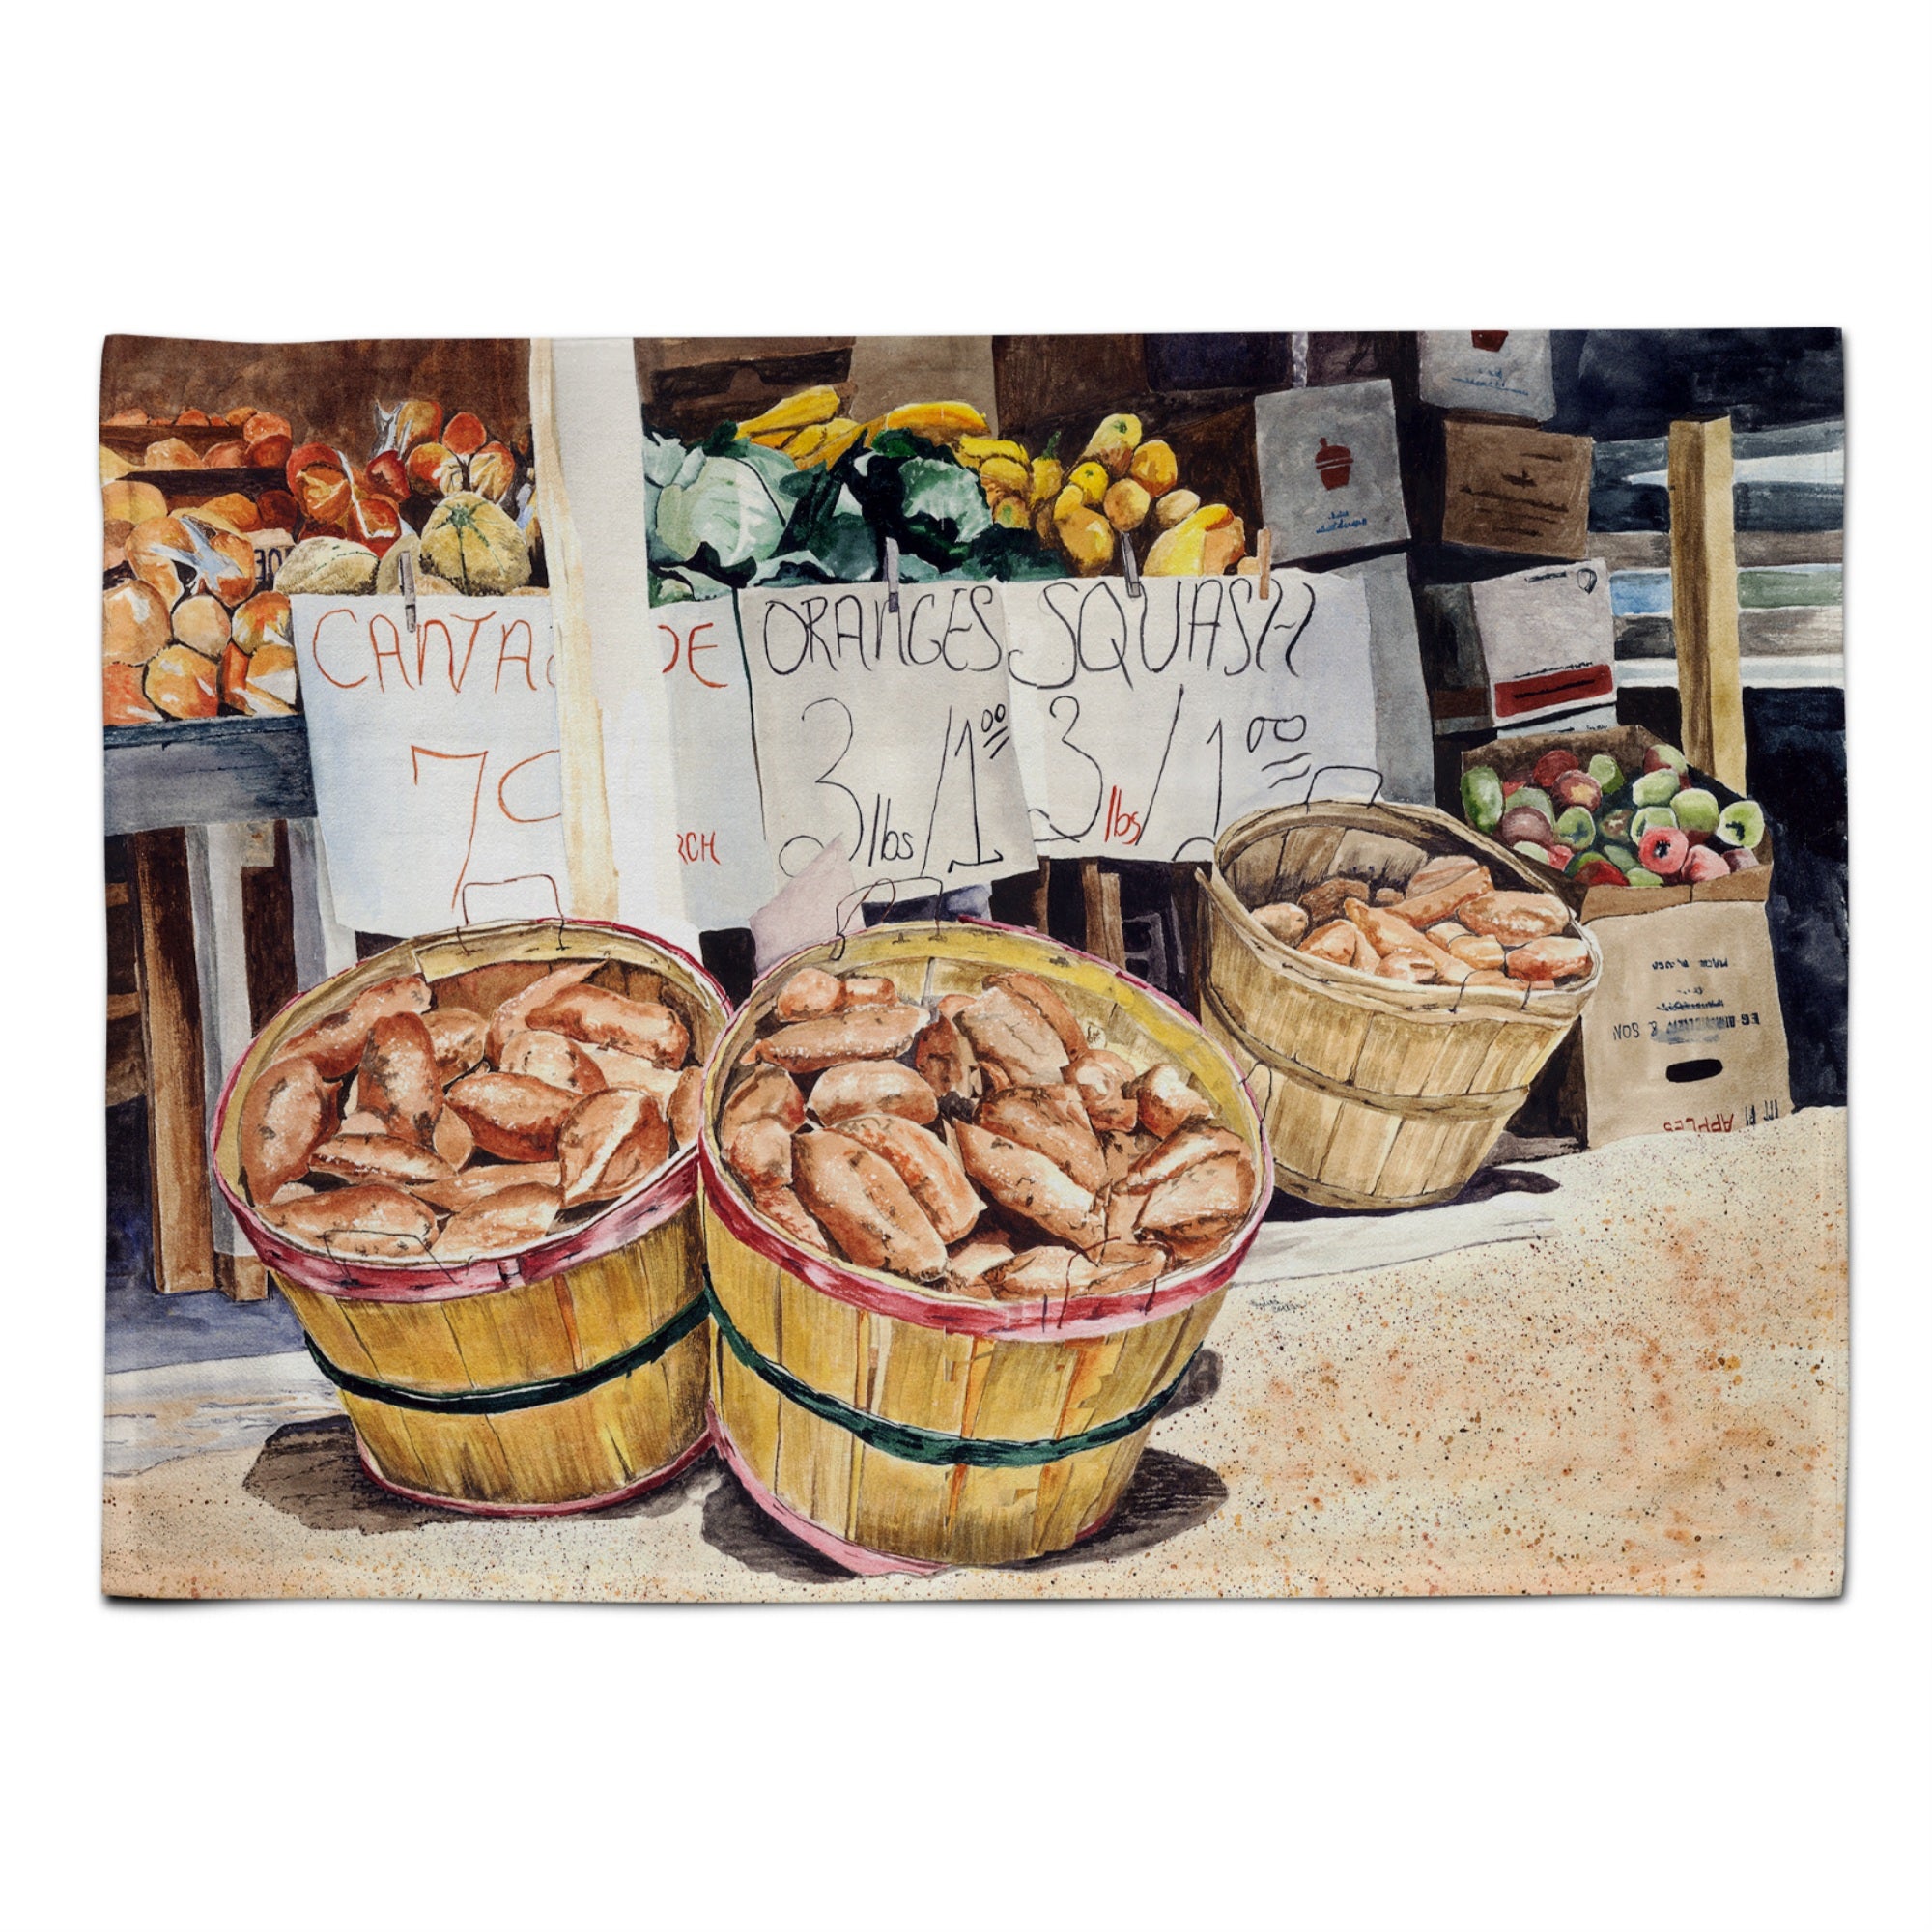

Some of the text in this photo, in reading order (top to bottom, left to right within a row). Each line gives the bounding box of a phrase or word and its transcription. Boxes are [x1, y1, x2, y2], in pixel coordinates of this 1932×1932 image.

[312, 609, 556, 694] CANTA
[764, 585, 1002, 676] ORANGES
[1008, 578, 1316, 690] SQUASH
[868, 793, 914, 867] lbs
[1104, 785, 1142, 846] lbs
